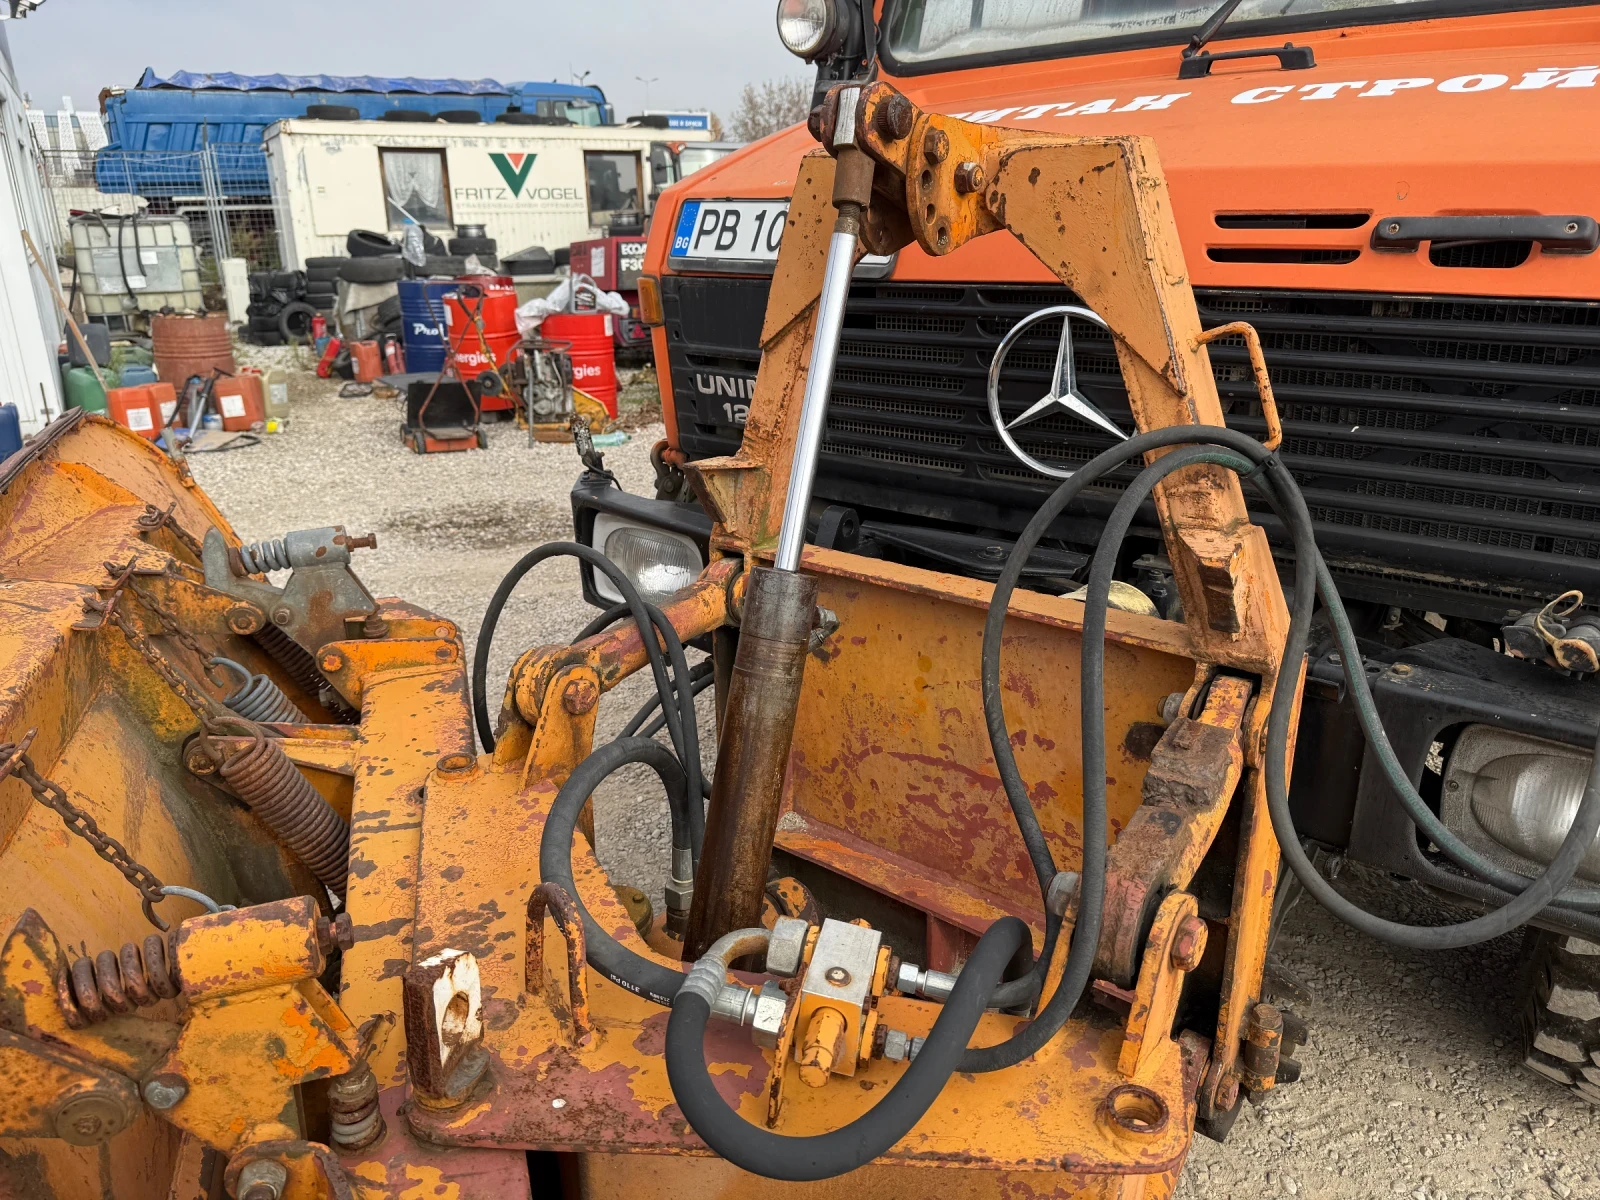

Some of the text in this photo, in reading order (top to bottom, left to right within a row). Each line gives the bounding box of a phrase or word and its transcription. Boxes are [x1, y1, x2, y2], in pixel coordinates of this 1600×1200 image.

[947, 65, 1600, 124] ИТАН СТРОЙ
[454, 187, 584, 200] FRITZ VOGEL
[693, 209, 741, 251] PB
[675, 236, 689, 249] BG
[621, 980, 640, 993] 3110
